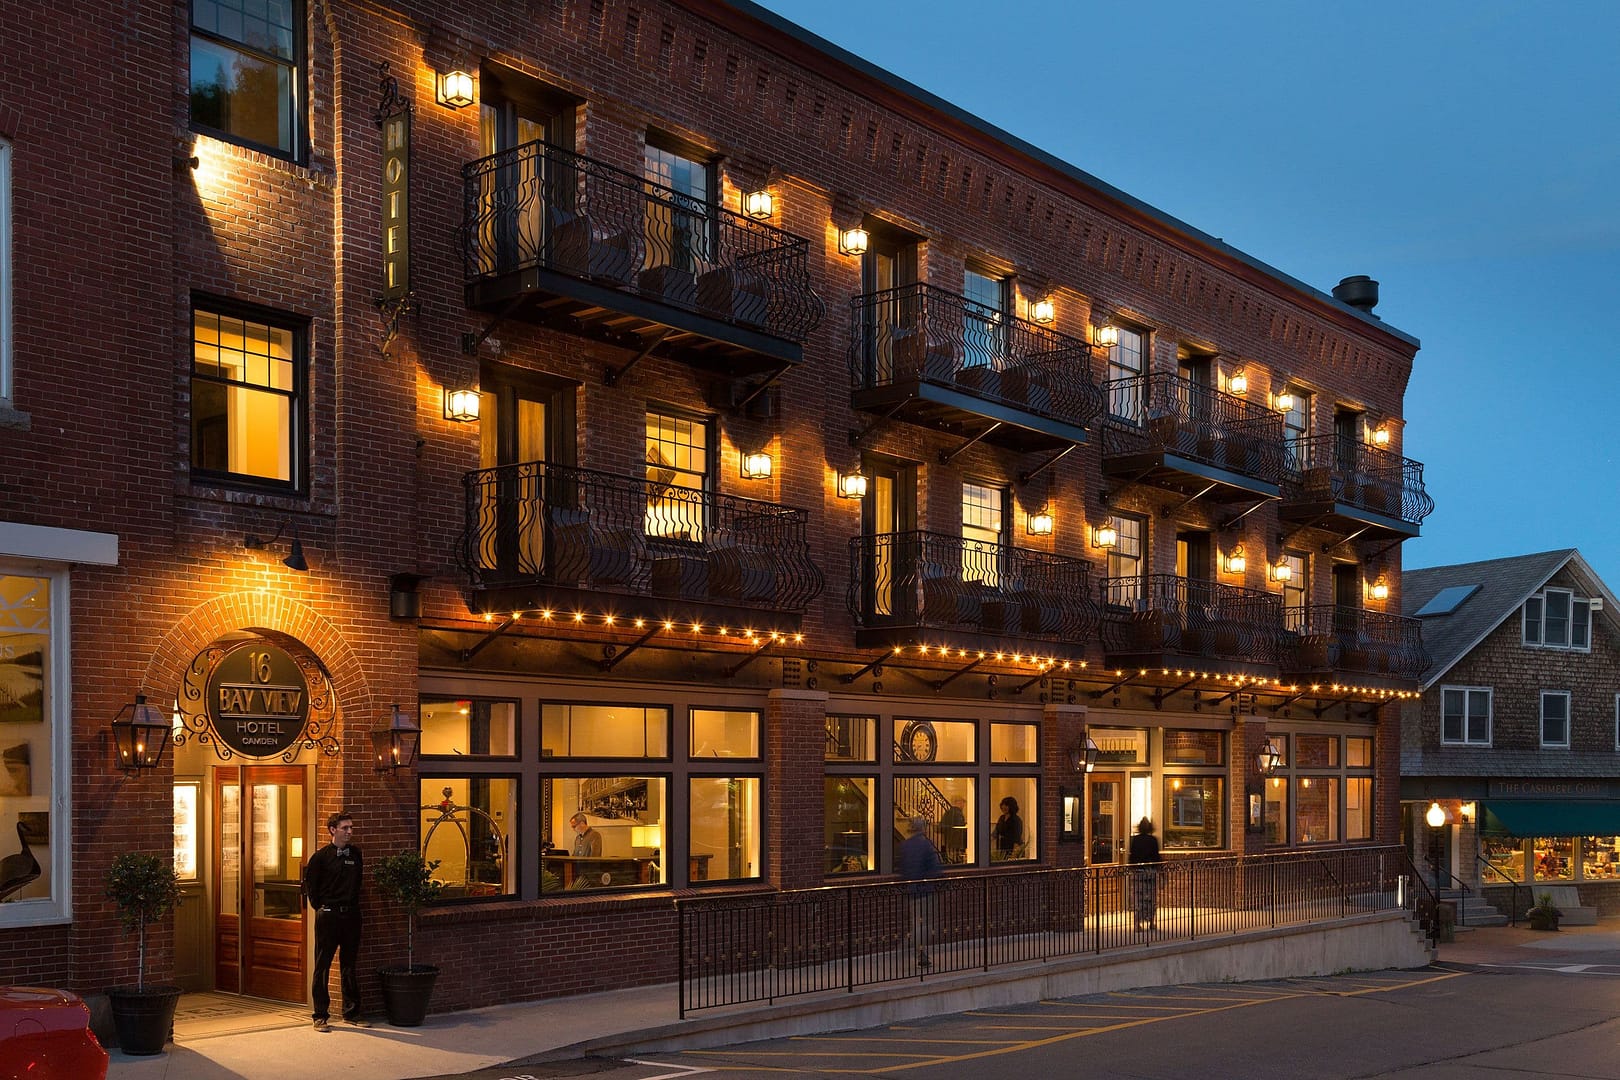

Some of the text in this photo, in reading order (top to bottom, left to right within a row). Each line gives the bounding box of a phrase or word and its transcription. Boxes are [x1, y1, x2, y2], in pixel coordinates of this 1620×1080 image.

[386, 120, 404, 289] HOTEL
[249, 652, 272, 684] 16
[219, 688, 301, 714] BAY VIEW
[236, 721, 285, 734] HOTEL
[242, 737, 278, 745] CAMDEN
